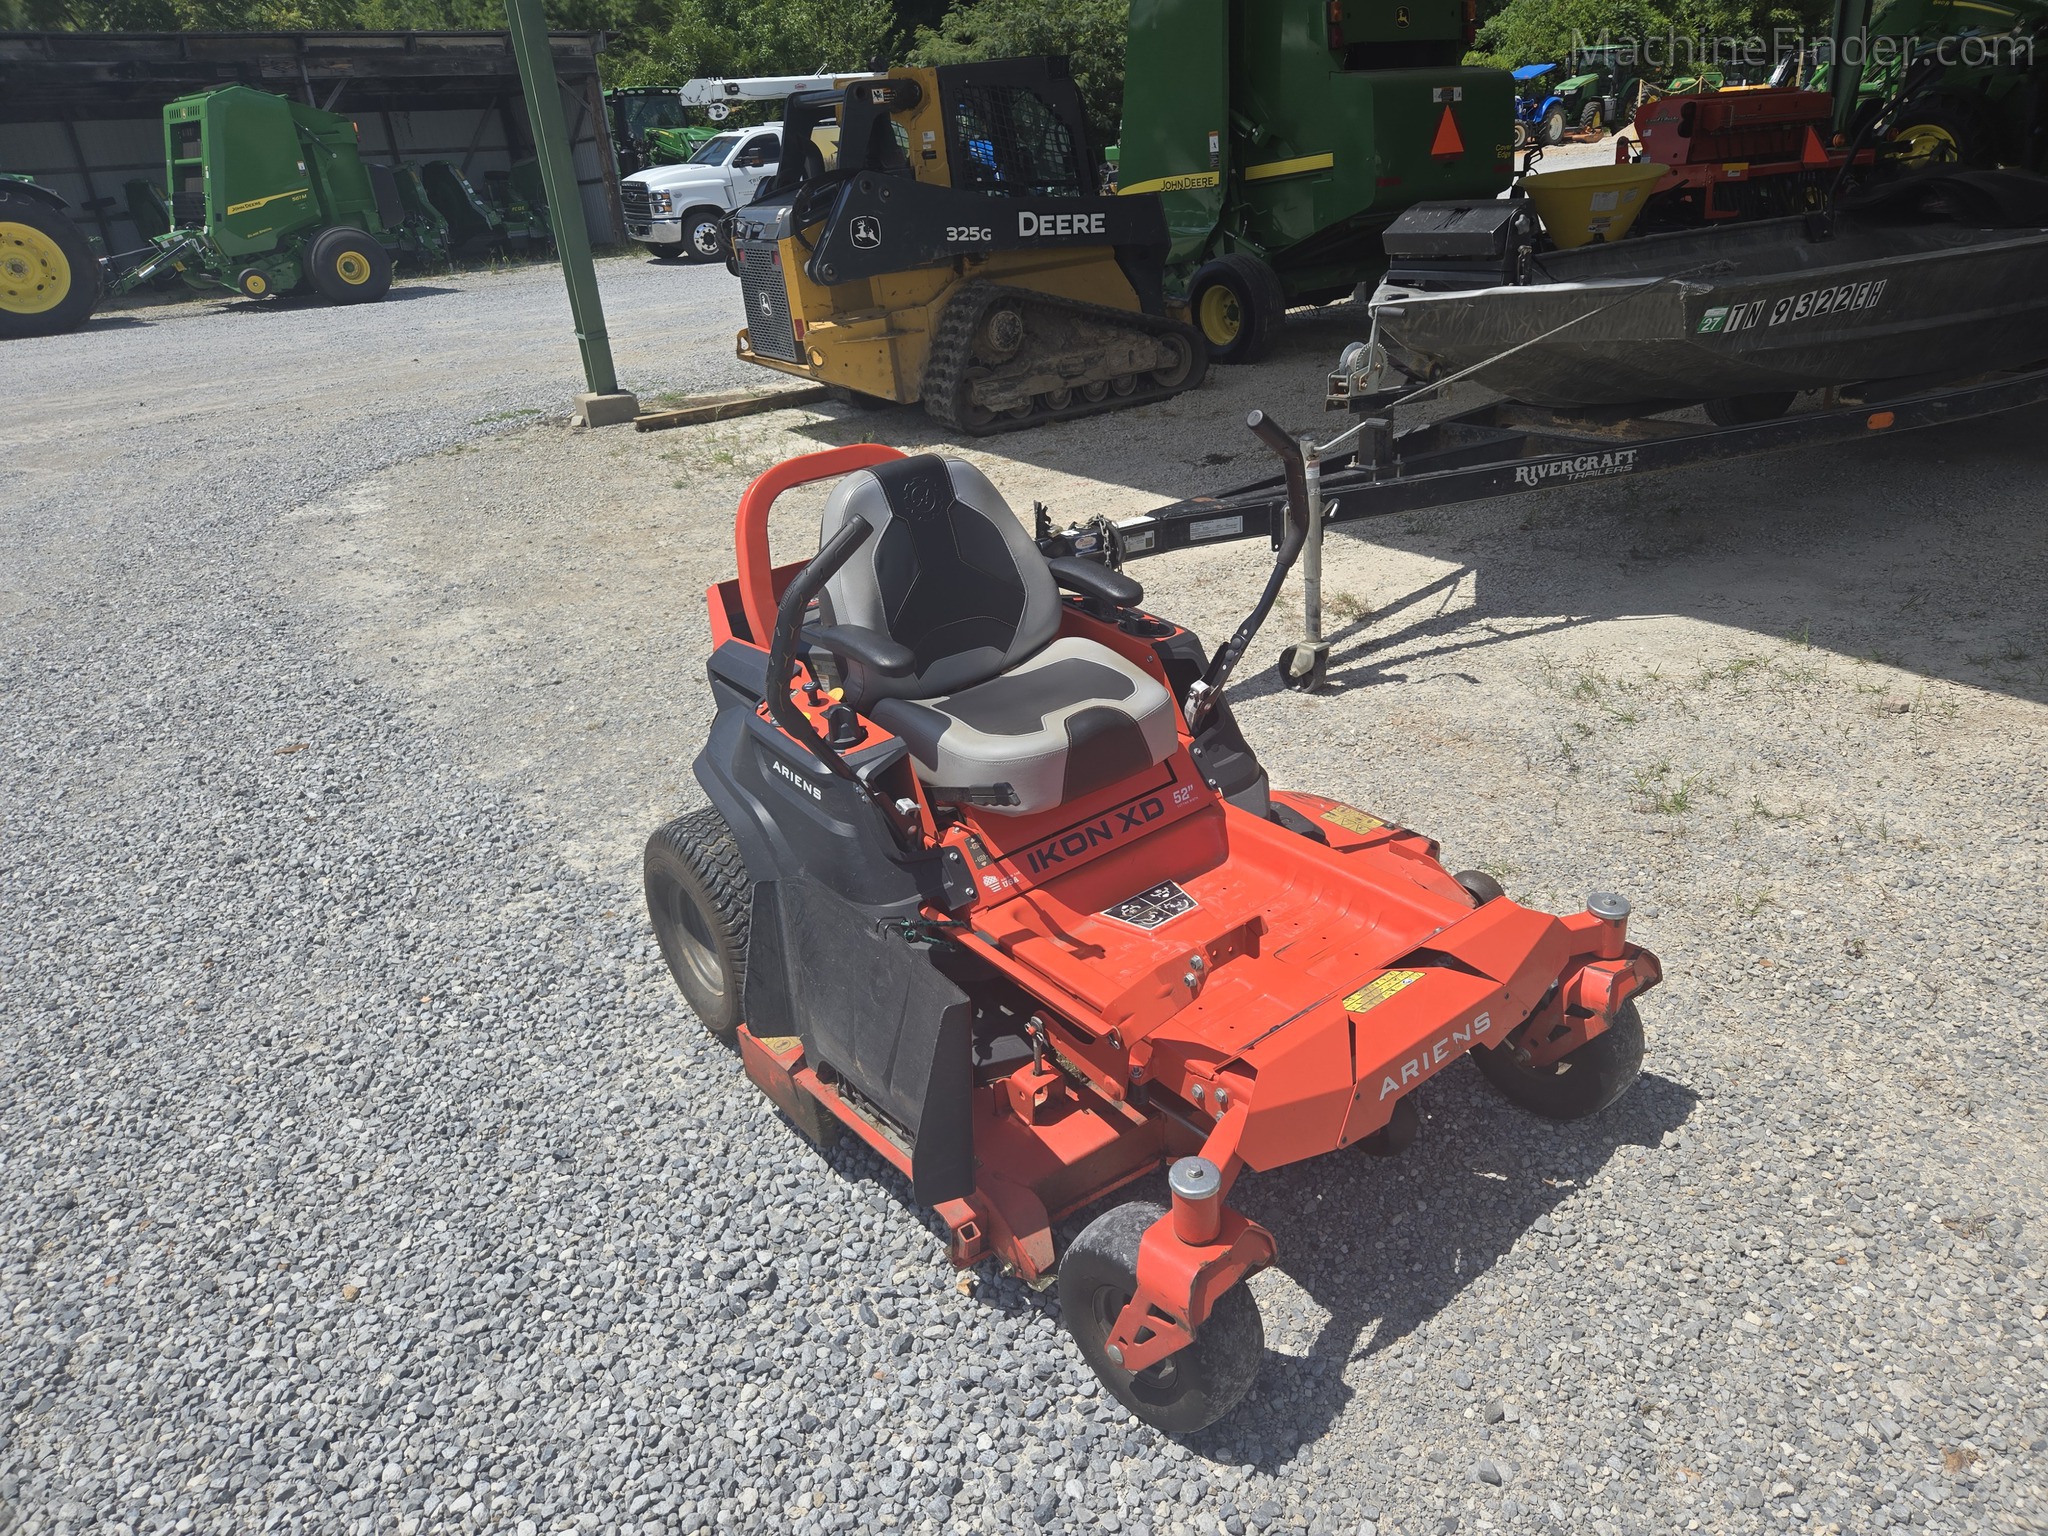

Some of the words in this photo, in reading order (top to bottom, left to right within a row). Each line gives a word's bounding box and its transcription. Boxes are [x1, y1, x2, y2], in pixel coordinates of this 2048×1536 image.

[1160, 179, 1184, 191] JOHN
[1184, 176, 1214, 189] DEERE
[244, 200, 261, 209] DEERE
[946, 226, 992, 242] 325G
[1018, 211, 1106, 237] DEERE
[1727, 301, 1764, 332] TN
[1772, 280, 1888, 325] 9322EH
[1701, 316, 1721, 332] 27
[1514, 449, 1638, 487] RIVERCRAFT
[1566, 464, 1633, 481] TRAILERS
[772, 760, 822, 801] ARIENS
[1026, 819, 1114, 874] IKON
[1114, 797, 1165, 834] XD
[1379, 1011, 1492, 1101] ARIENS
